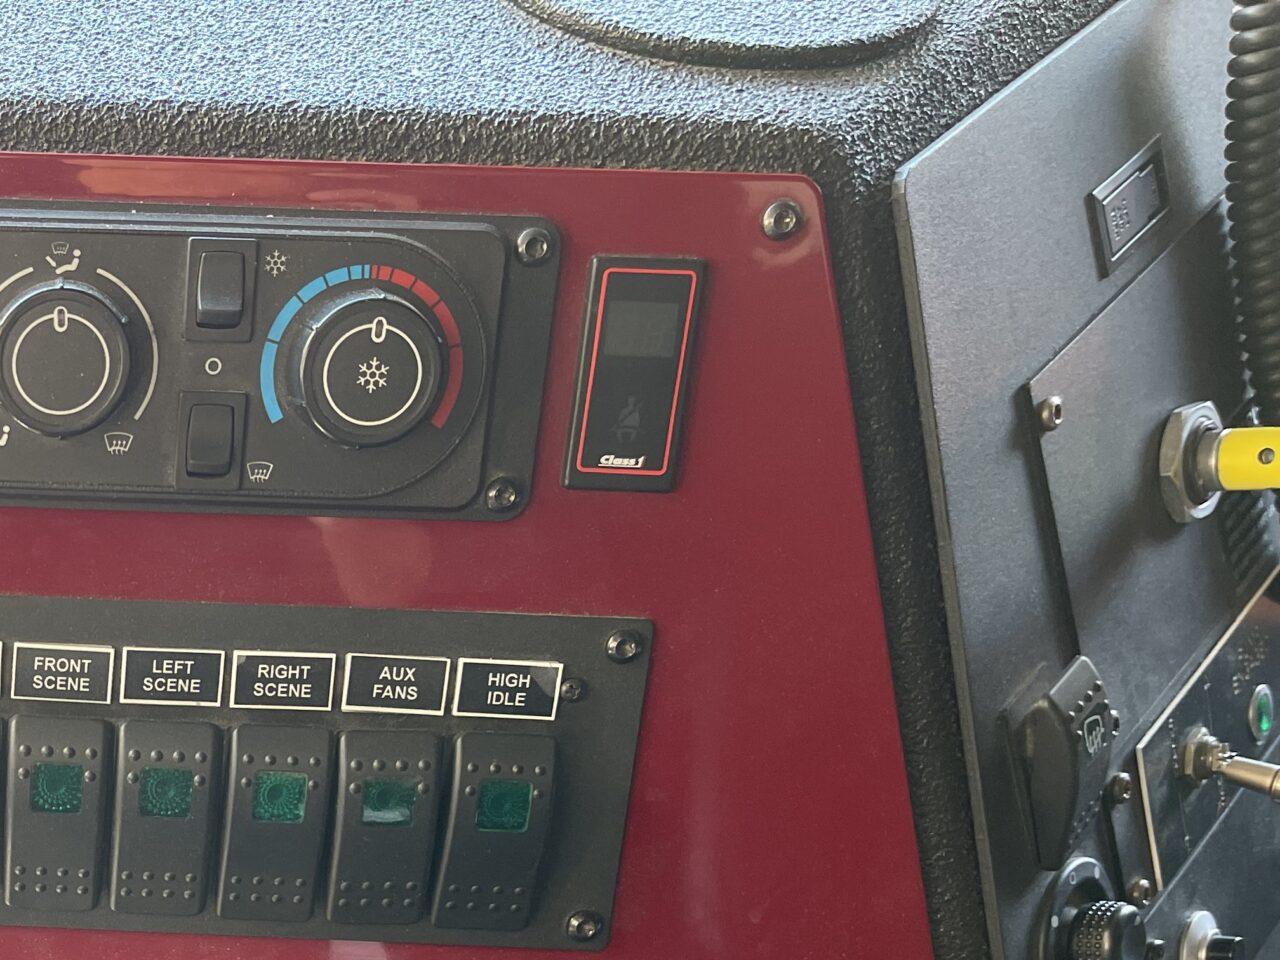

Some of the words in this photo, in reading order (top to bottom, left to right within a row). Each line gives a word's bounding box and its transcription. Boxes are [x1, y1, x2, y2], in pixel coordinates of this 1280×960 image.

[33, 656, 92, 674] FRONT
[152, 659, 195, 675] LEFT
[257, 664, 312, 680] RIGHT
[379, 666, 416, 682] AUX
[487, 672, 531, 689] HIGH
[32, 674, 90, 692] SCENE
[142, 676, 201, 693] SCENE
[253, 682, 312, 699] SCENE
[372, 684, 419, 701] FANS
[486, 691, 527, 707] IDLE
